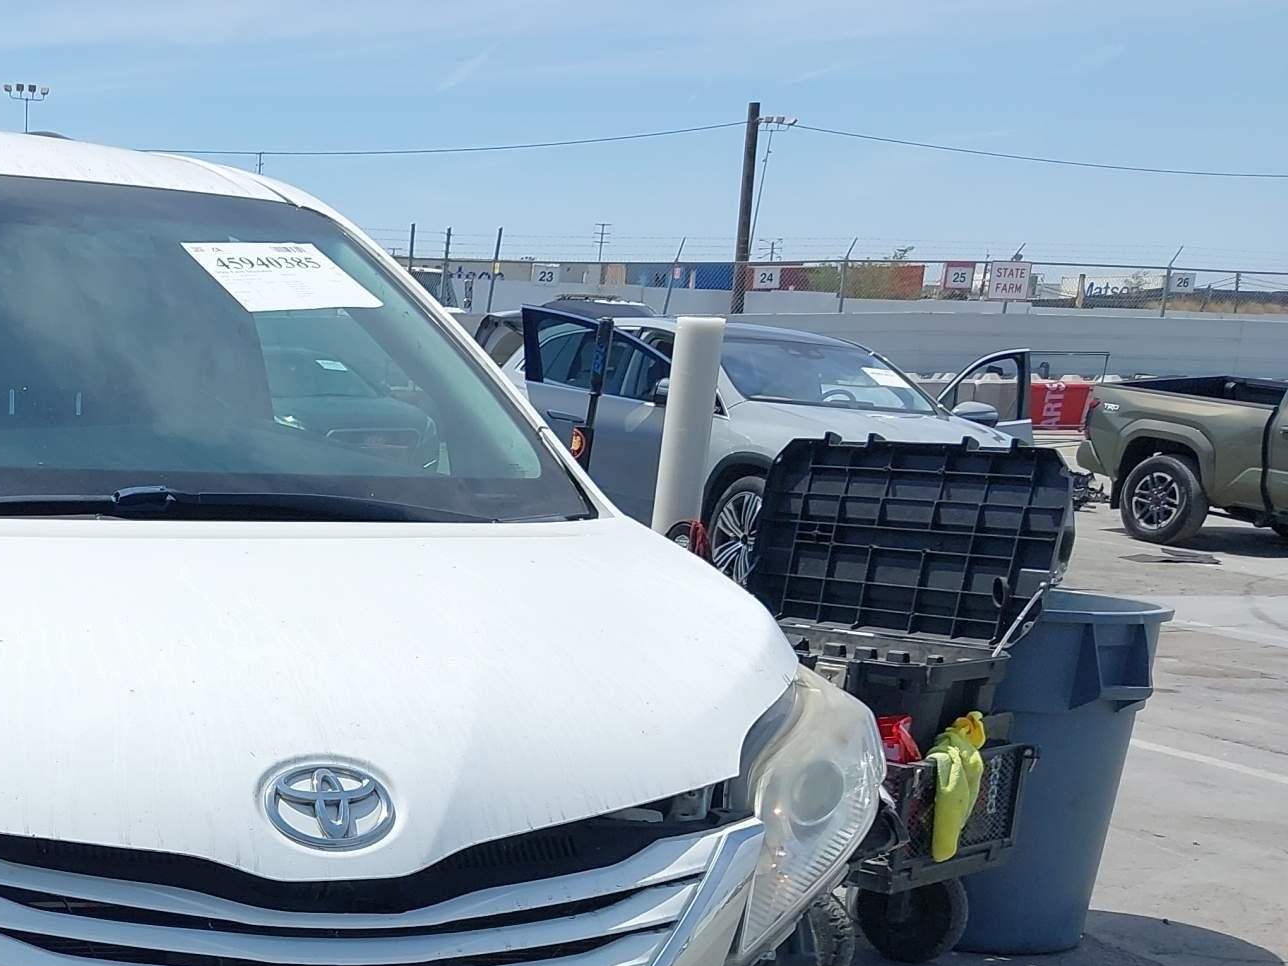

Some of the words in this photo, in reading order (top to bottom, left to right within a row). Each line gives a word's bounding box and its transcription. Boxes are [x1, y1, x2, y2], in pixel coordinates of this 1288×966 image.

[215, 255, 322, 270] 45940385
[538, 270, 554, 283] 23
[759, 271, 774, 284] 24
[952, 271, 967, 283] 25
[996, 267, 1026, 279] STATE
[994, 282, 1023, 294] FARM
[1176, 277, 1190, 288] 26
[1086, 281, 1141, 298] Matso
[1103, 402, 1120, 411] TRD
